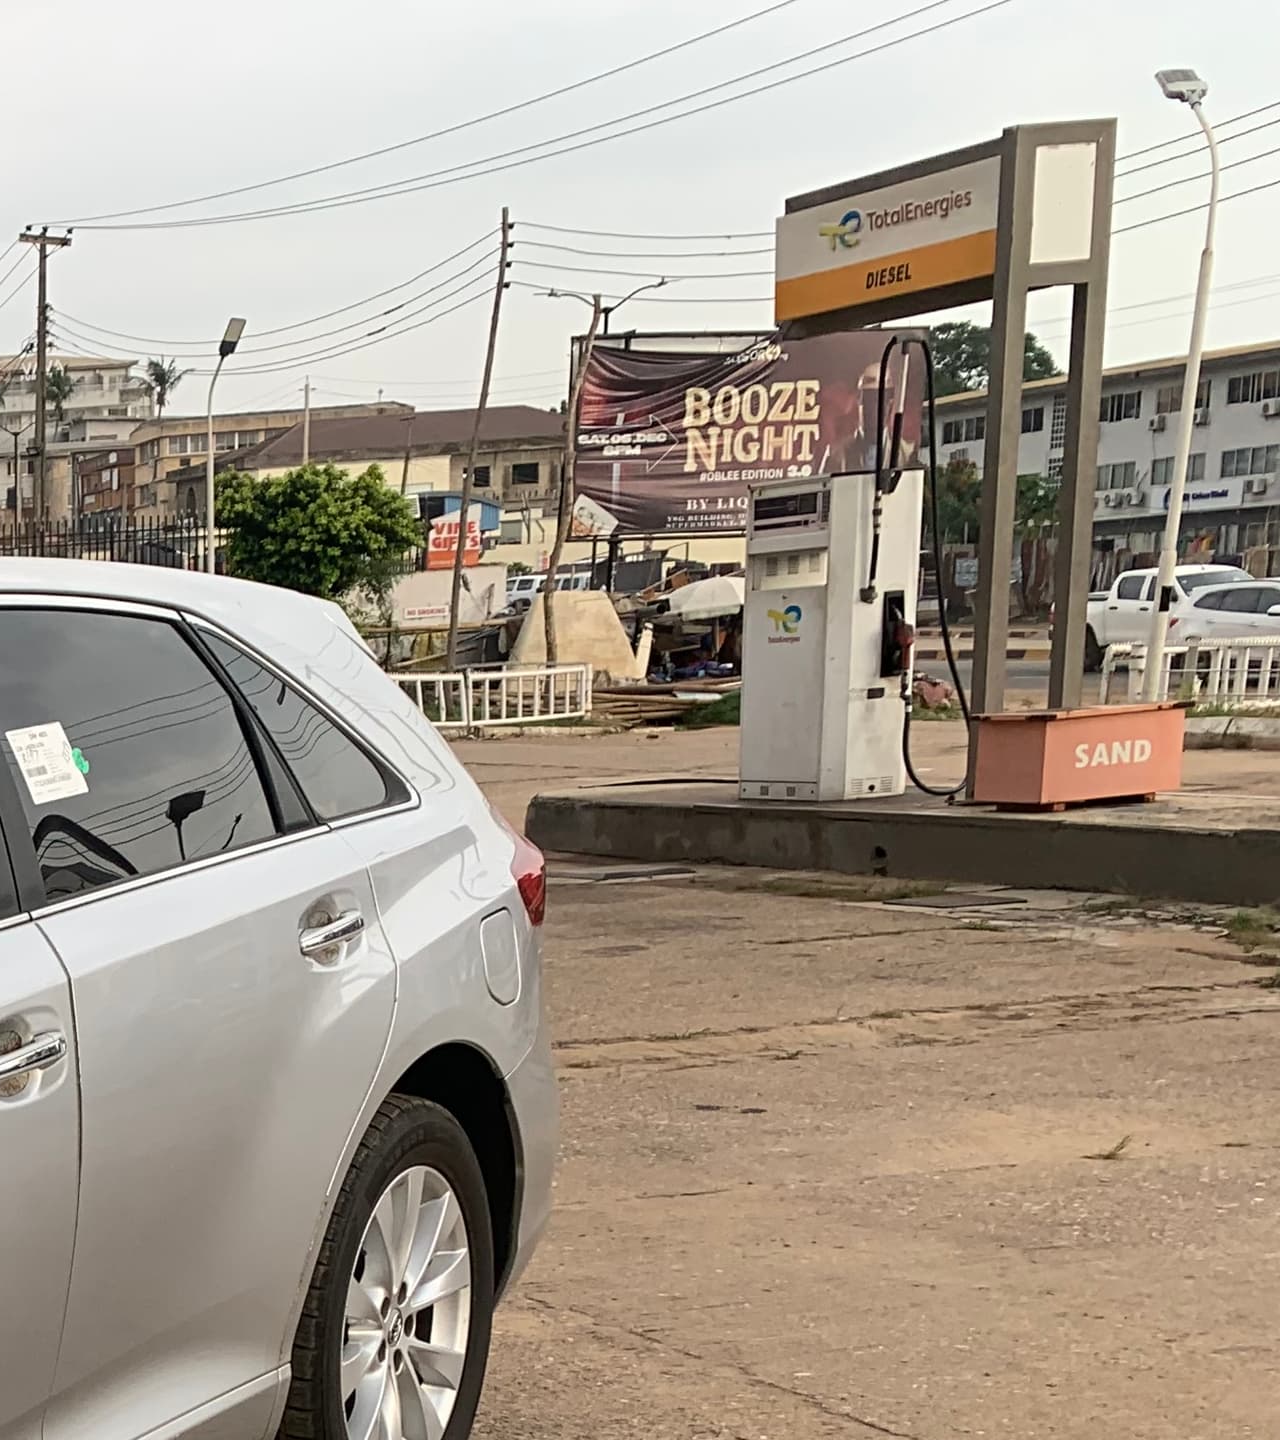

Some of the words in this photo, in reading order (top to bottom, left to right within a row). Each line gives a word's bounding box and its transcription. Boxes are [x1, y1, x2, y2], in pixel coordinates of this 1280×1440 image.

[866, 190, 972, 232] TotalEnergies
[865, 263, 912, 290] DIESEL
[683, 380, 821, 428] BOOZE
[683, 424, 820, 473] NIGHT
[741, 468, 783, 481] EDITION
[786, 465, 812, 477] 3.0
[686, 498, 709, 511] BY
[717, 497, 748, 510] LIQ
[432, 536, 479, 549] GIFS
[417, 607, 446, 616] SMOKING
[1074, 739, 1152, 769] SAND
